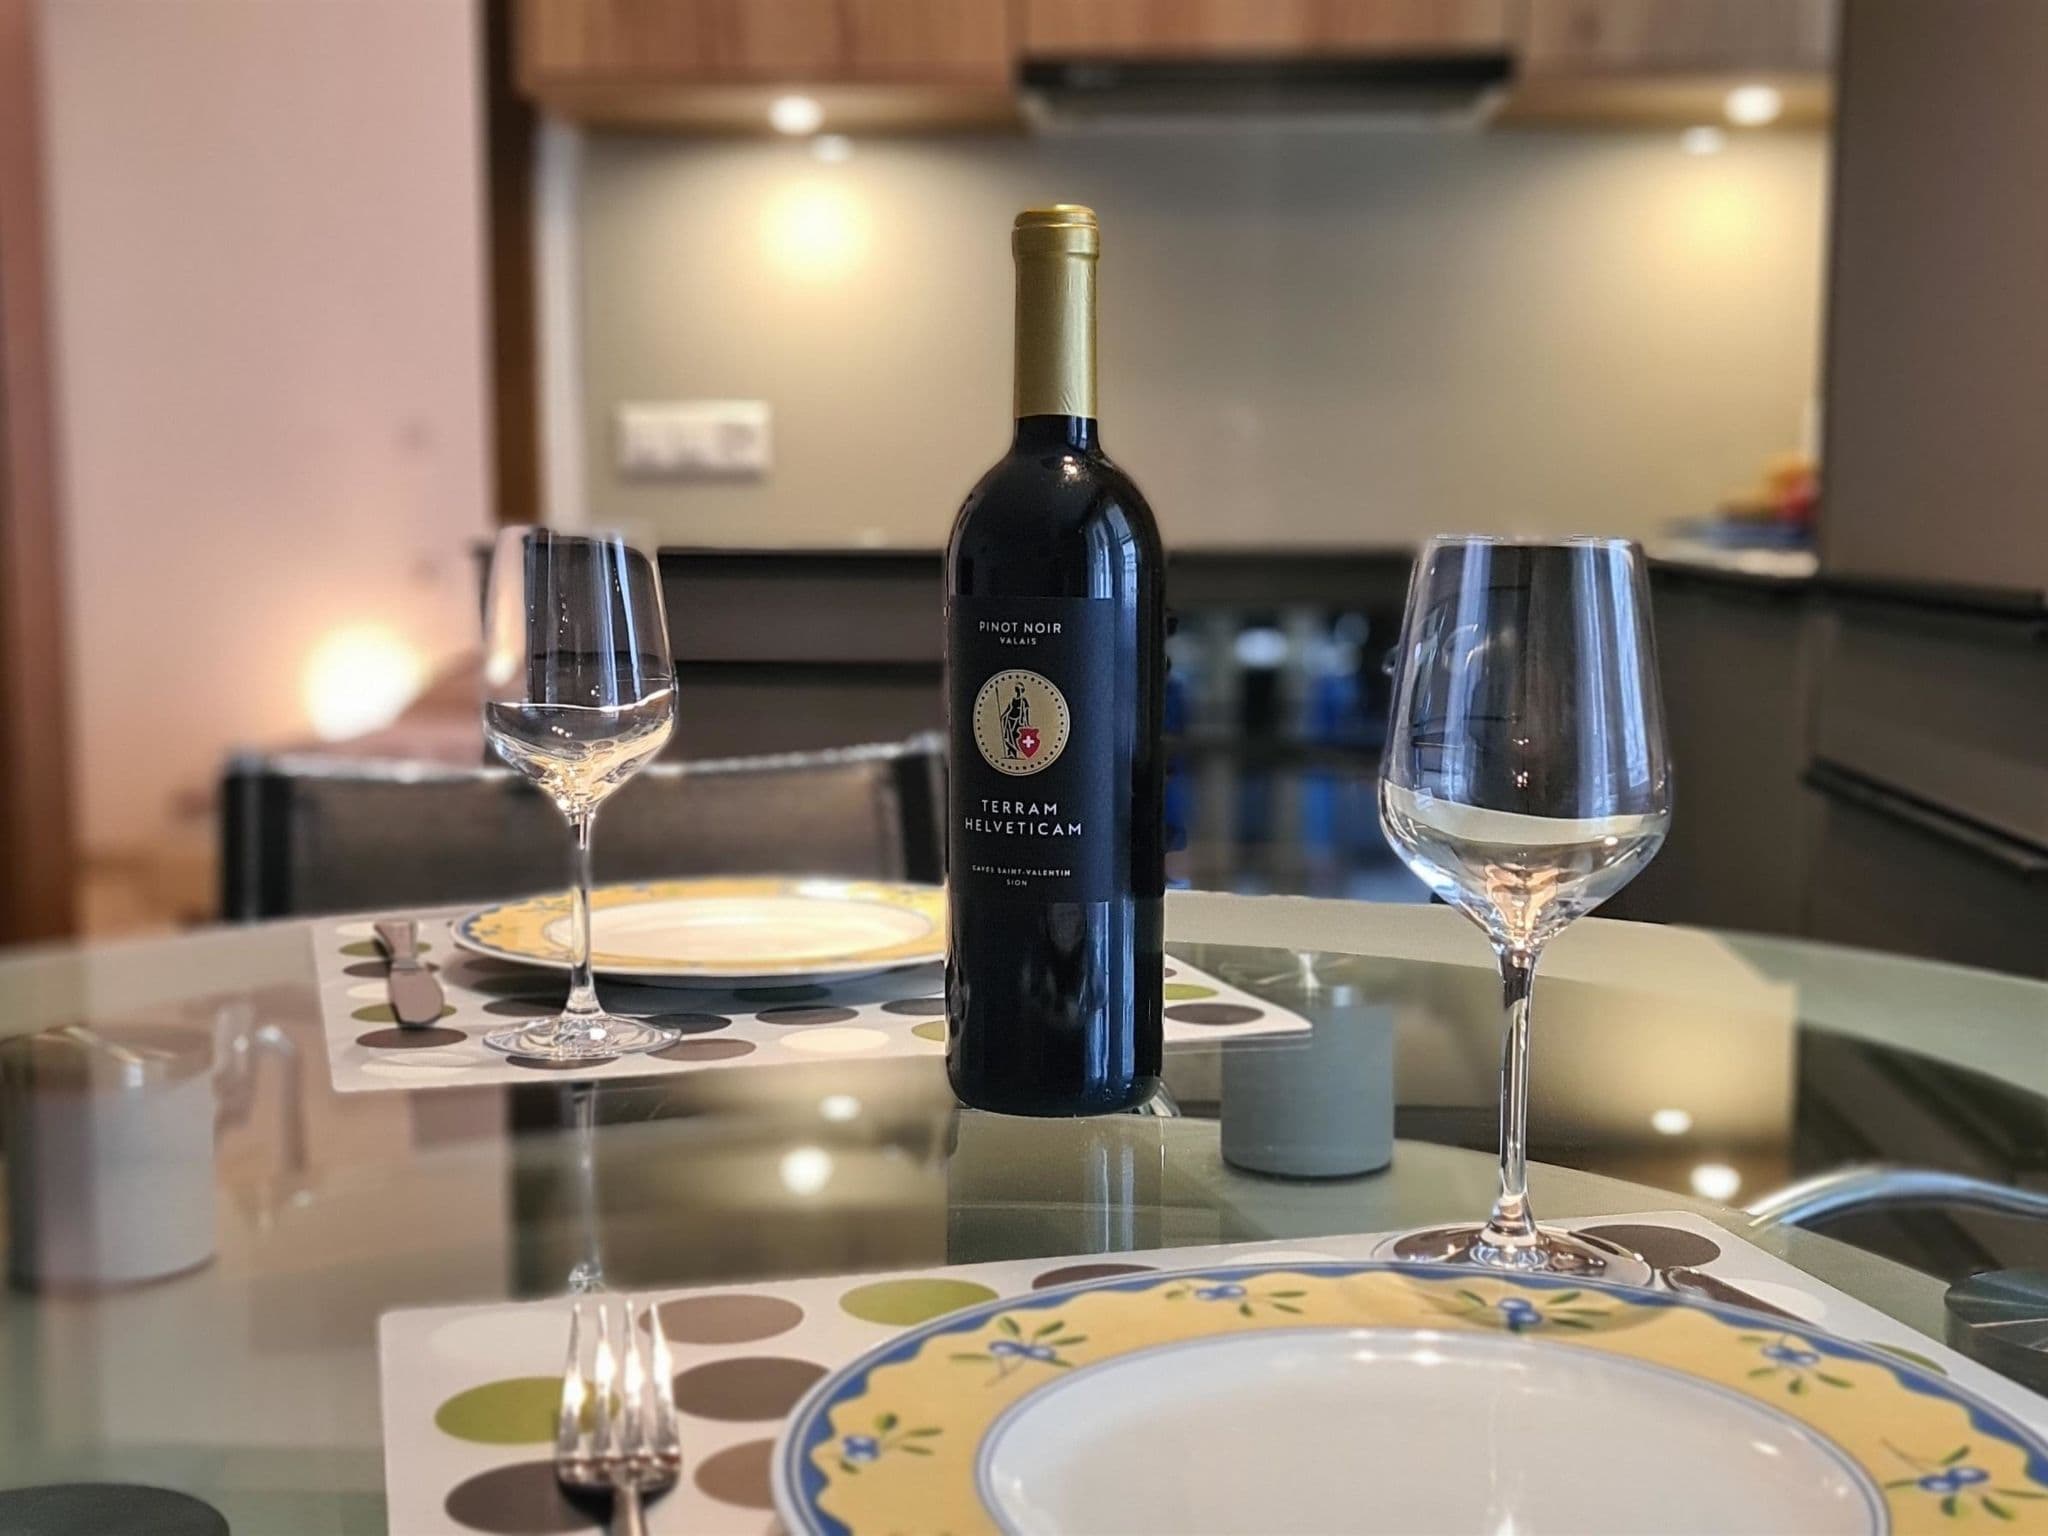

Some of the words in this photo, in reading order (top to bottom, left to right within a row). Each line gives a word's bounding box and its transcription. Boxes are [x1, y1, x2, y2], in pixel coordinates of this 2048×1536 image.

[979, 621, 1018, 633] PINOT
[1023, 622, 1062, 634] NOIR
[1000, 636, 1037, 646] VALAIS
[981, 799, 1058, 816] TERRAM
[965, 817, 1081, 836] HELVETICAM
[997, 867, 1071, 877] SAINT-VALENTIN
[1006, 879, 1028, 887] SION
